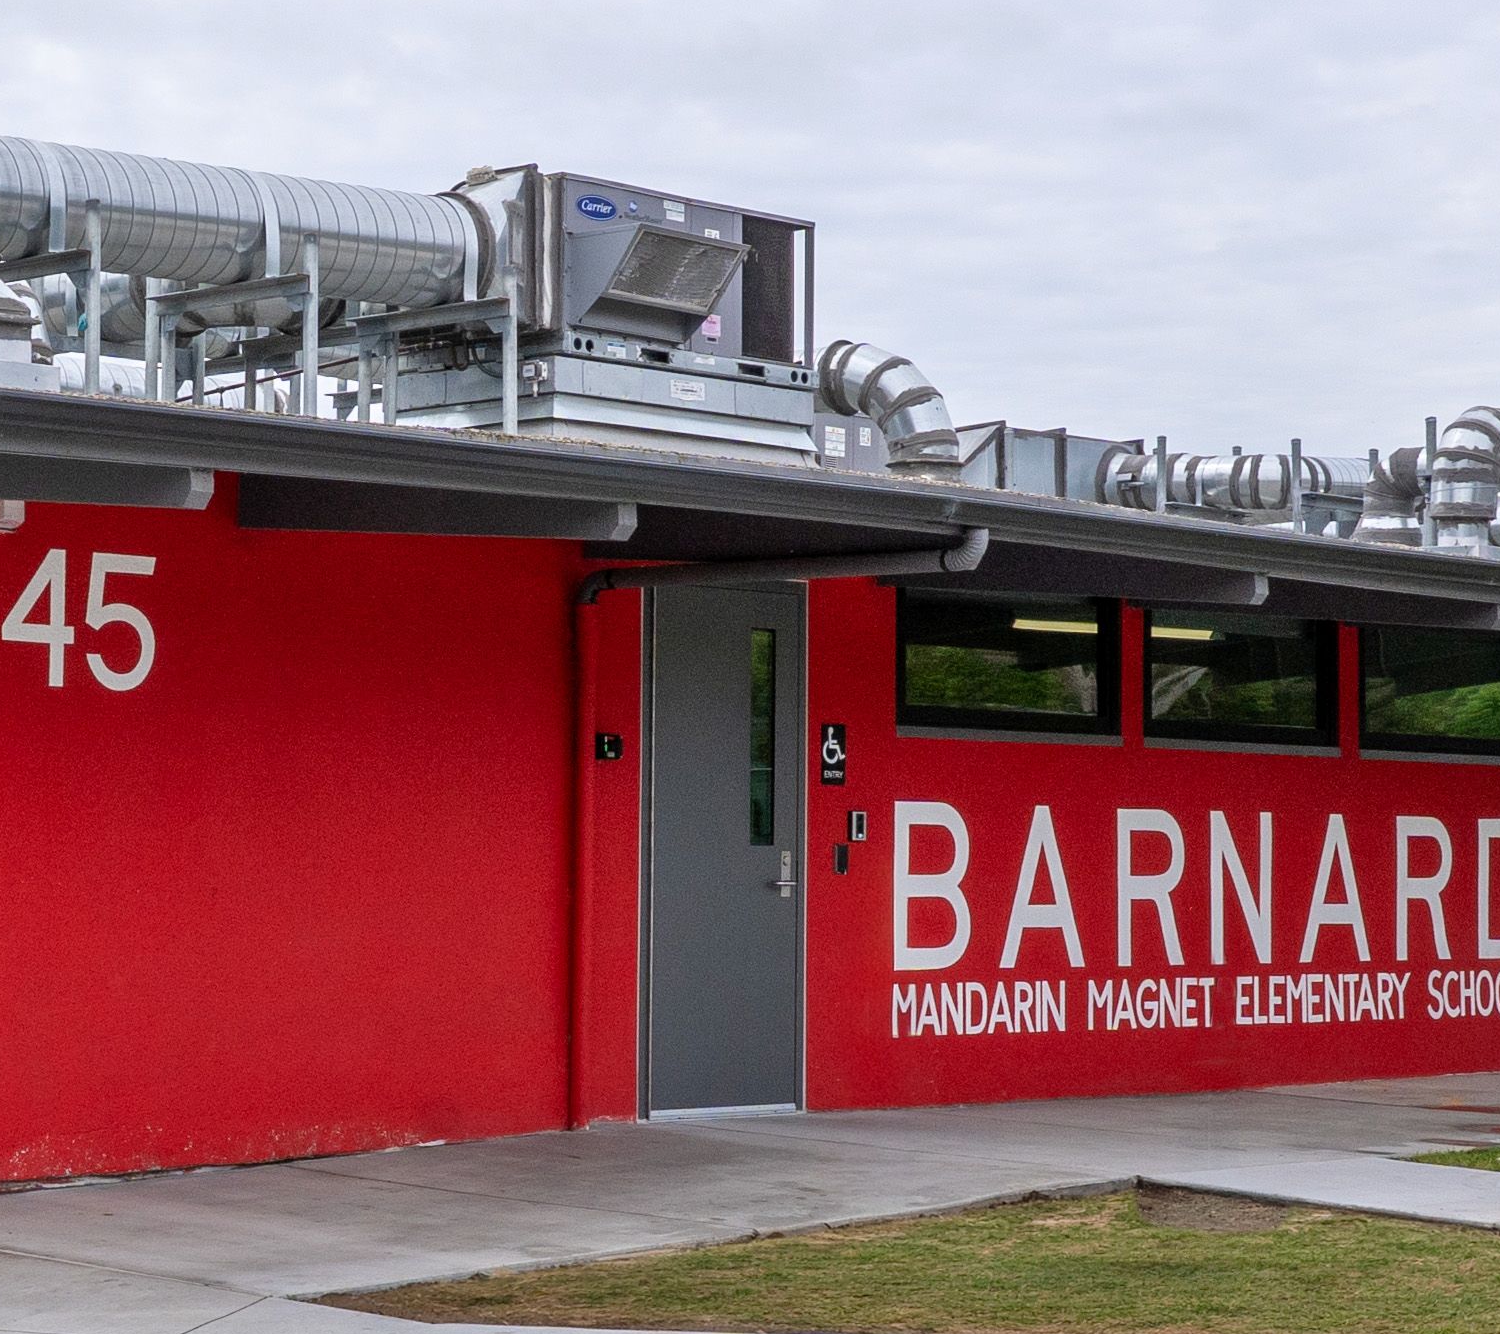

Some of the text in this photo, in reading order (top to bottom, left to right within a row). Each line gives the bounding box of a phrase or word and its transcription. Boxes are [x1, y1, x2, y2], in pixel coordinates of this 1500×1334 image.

[581, 199, 613, 215] Carrier
[891, 980, 1067, 1038] MANDARIN
[1087, 976, 1215, 1031] MAGNET
[1234, 970, 1411, 1025] ELEMENTARY
